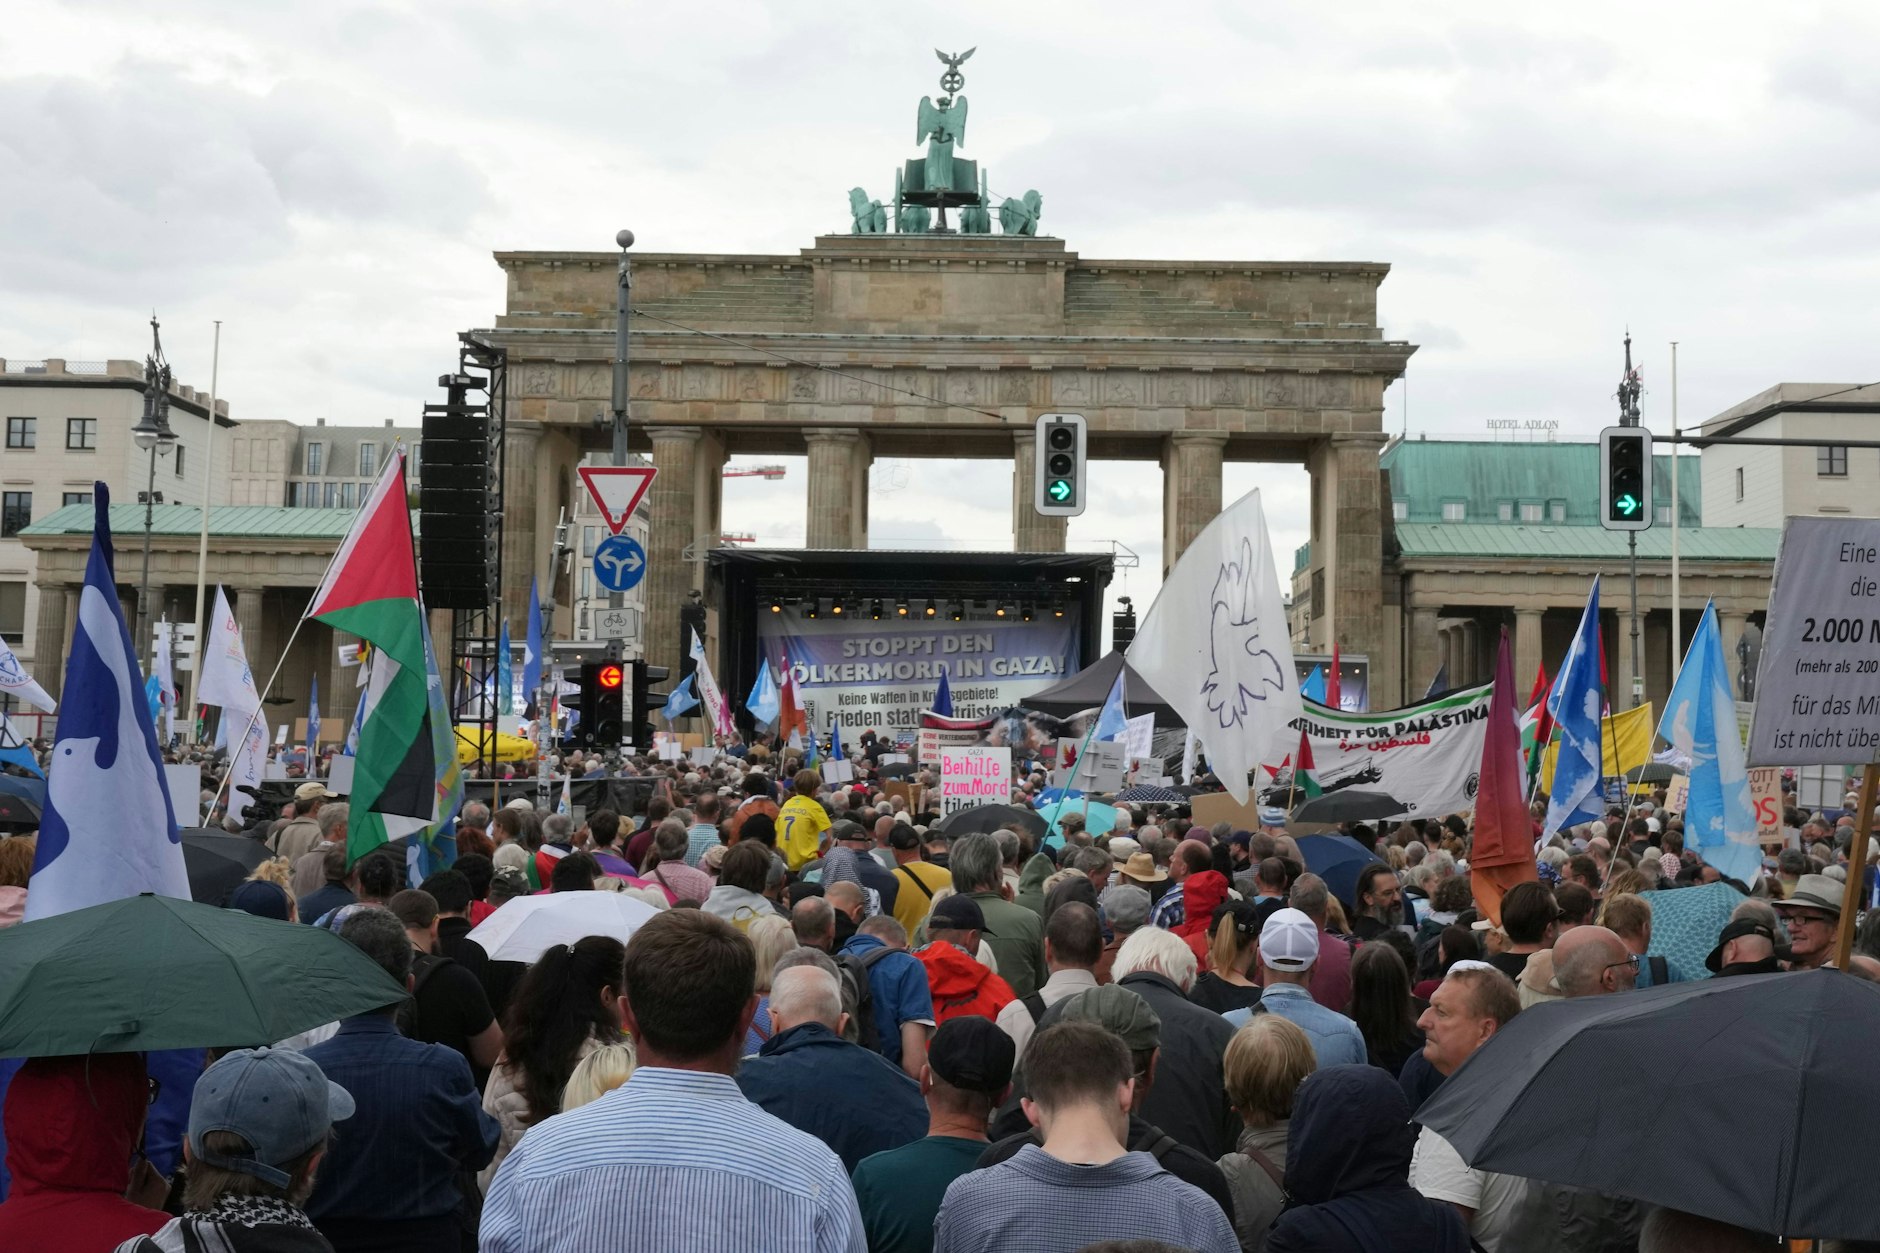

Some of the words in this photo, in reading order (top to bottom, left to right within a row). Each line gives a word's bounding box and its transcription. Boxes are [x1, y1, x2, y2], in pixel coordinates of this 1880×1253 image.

[1487, 419, 1520, 429] HOTEL
[1524, 419, 1559, 430] ADLON
[1839, 542, 1877, 564] Eine
[1850, 576, 1877, 597] die
[609, 628, 623, 636] frei
[1801, 617, 1864, 643] 2.000
[843, 637, 938, 658] STOPPT
[942, 634, 994, 653] DEN
[957, 661, 984, 678] IN
[990, 655, 1065, 676] GAZA!
[1795, 658, 1832, 676] (mehr
[1834, 659, 1851, 674] als
[1856, 660, 1879, 674] 200
[838, 692, 867, 706] Keine
[870, 690, 906, 704] Waffen
[909, 690, 919, 703] in
[922, 687, 999, 703] Krisgebiete!
[1792, 694, 1818, 716] für
[1822, 694, 1852, 716] das
[826, 710, 882, 728] Frieden
[1355, 727, 1391, 739] FÜR
[1394, 704, 1489, 735] PALÄSTINA
[1773, 728, 1795, 749] ist
[1798, 727, 1844, 748] nicht
[943, 755, 1000, 778] Beihilfe
[784, 815, 796, 841] 7
